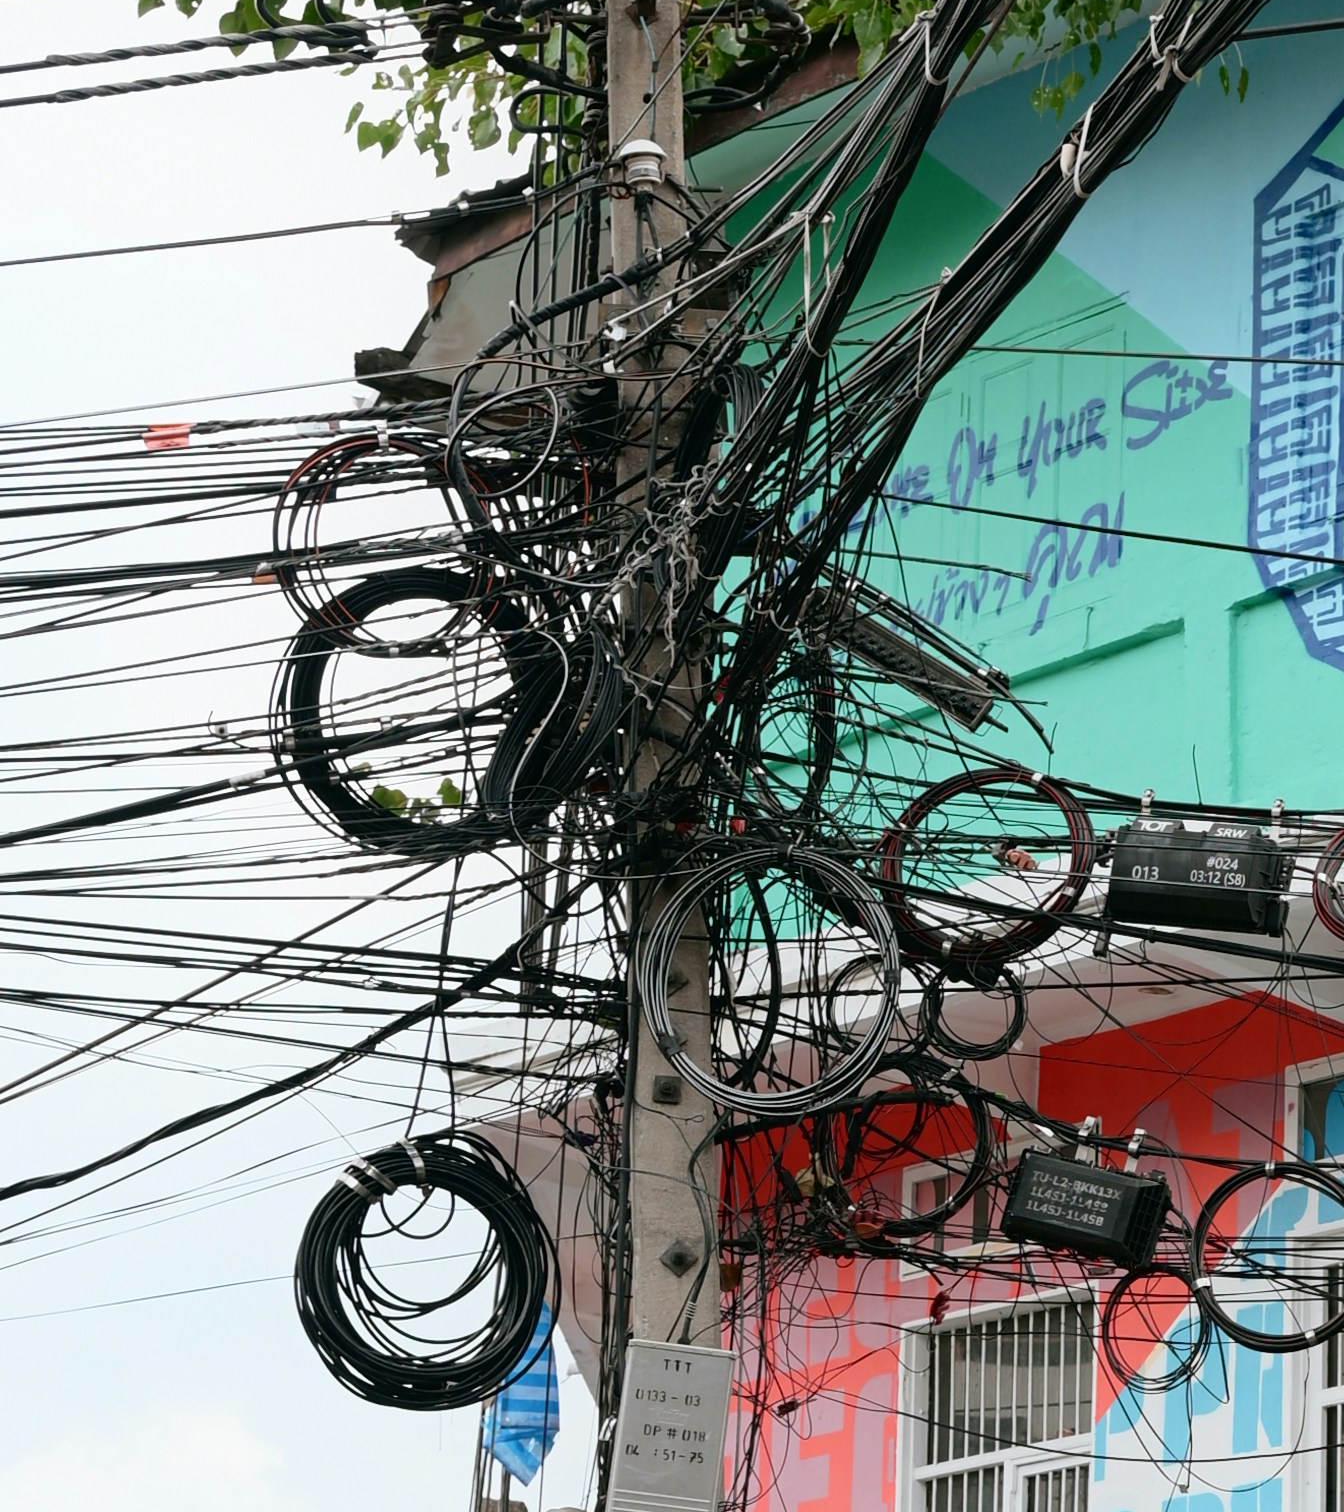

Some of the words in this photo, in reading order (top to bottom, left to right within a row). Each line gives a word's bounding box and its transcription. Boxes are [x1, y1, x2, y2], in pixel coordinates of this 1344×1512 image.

[1136, 819, 1174, 832] TOT
[1214, 827, 1248, 838] SRW
[1206, 856, 1239, 870] #024
[1131, 865, 1160, 881] 013
[1189, 870, 1221, 884] 03:12
[643, 1423, 662, 1437] DP
